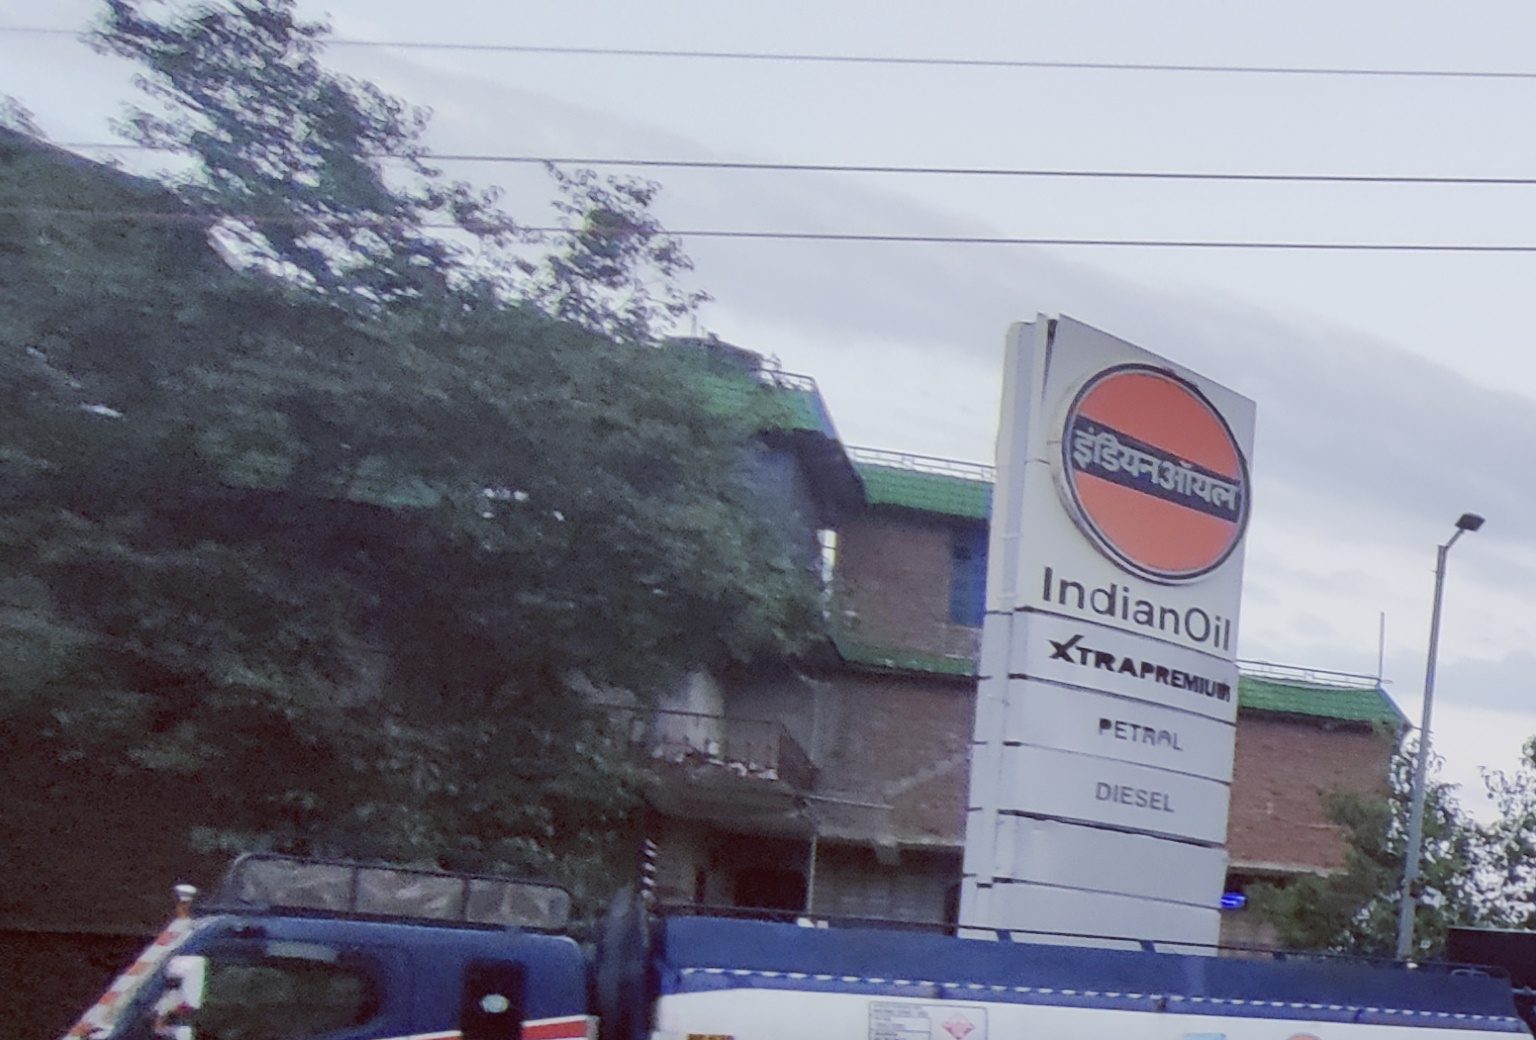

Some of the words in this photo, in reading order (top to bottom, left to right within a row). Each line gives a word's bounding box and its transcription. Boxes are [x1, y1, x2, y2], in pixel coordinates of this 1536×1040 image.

[1073, 426, 1238, 511] इंडियनऑयल
[1043, 566, 1231, 651] IndianOil
[1096, 782, 1175, 812] DIESEL
